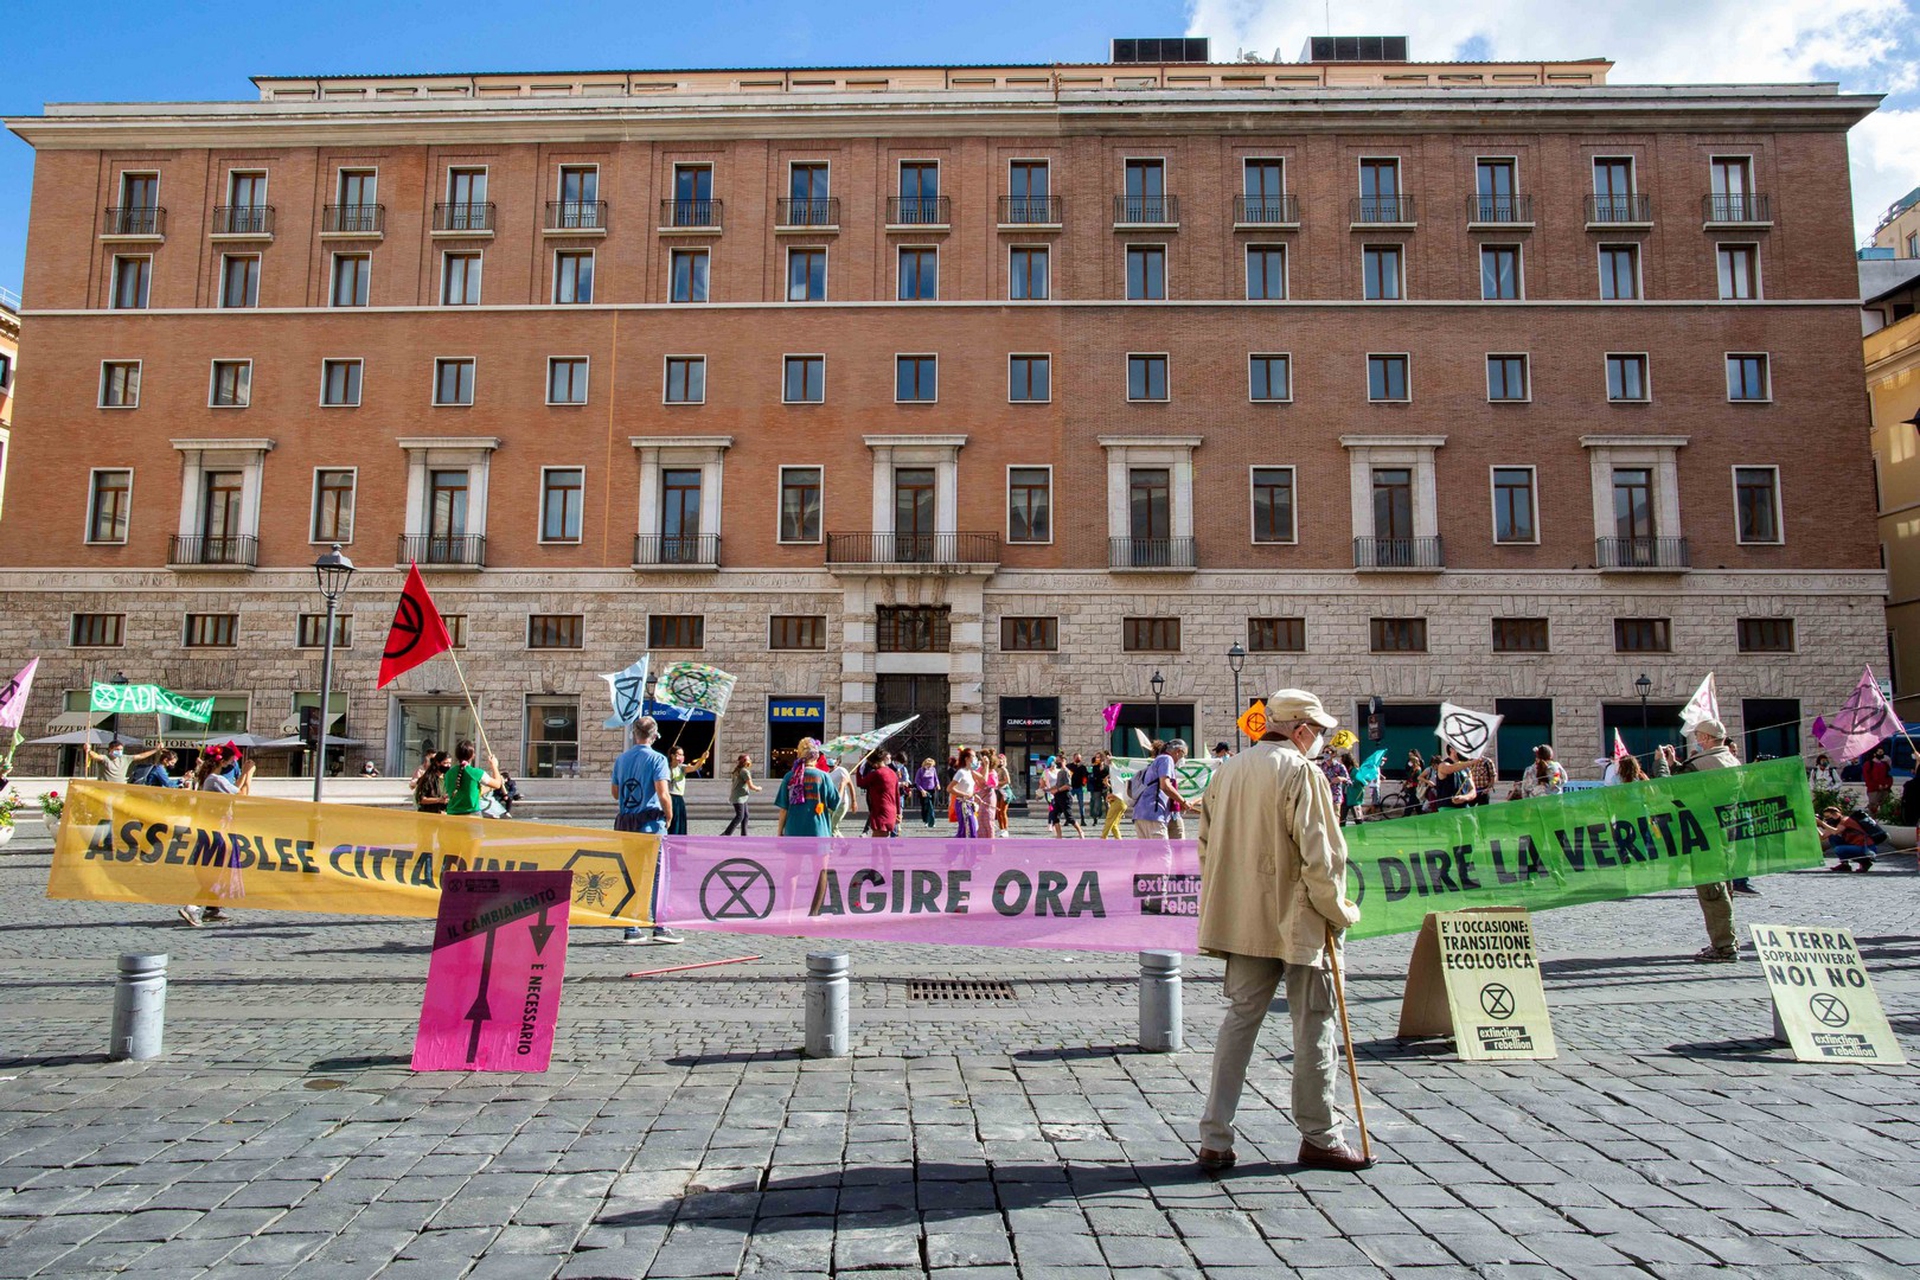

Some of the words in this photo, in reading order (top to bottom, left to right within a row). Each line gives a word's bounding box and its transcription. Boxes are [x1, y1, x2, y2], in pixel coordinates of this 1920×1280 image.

[773, 707, 820, 717] IKEA
[48, 725, 93, 733] PIZZERI
[1720, 800, 1779, 822] extinction
[1741, 815, 1795, 837] rebellion
[84, 819, 320, 873] ASSEMBLEE
[1378, 844, 1481, 902] DIRE
[1490, 835, 1549, 884] LA
[1555, 800, 1710, 872] VERITÀ
[1137, 876, 1202, 893] extinctio
[808, 869, 972, 916] AGIRE
[992, 869, 1106, 918] ORA
[447, 925, 460, 939] IL
[463, 888, 556, 932] CAMBIAMENTO
[1454, 920, 1529, 933] L'OCCASIONE:
[1443, 935, 1531, 950] TRANSIZIONE
[1755, 930, 1781, 947] LA
[1786, 931, 1853, 950] TERRA
[1446, 953, 1535, 969] ECOLOGICA
[1762, 951, 1856, 965] SOPRAVVIVERA'
[1768, 965, 1817, 986] NOI
[1825, 967, 1866, 988] NO
[517, 976, 543, 1055] NECESSARIO
[1479, 1027, 1520, 1038] extinction
[1814, 1034, 1860, 1045] extinction
[1494, 1038, 1532, 1050] rebellion
[1832, 1045, 1875, 1057] rebellion
